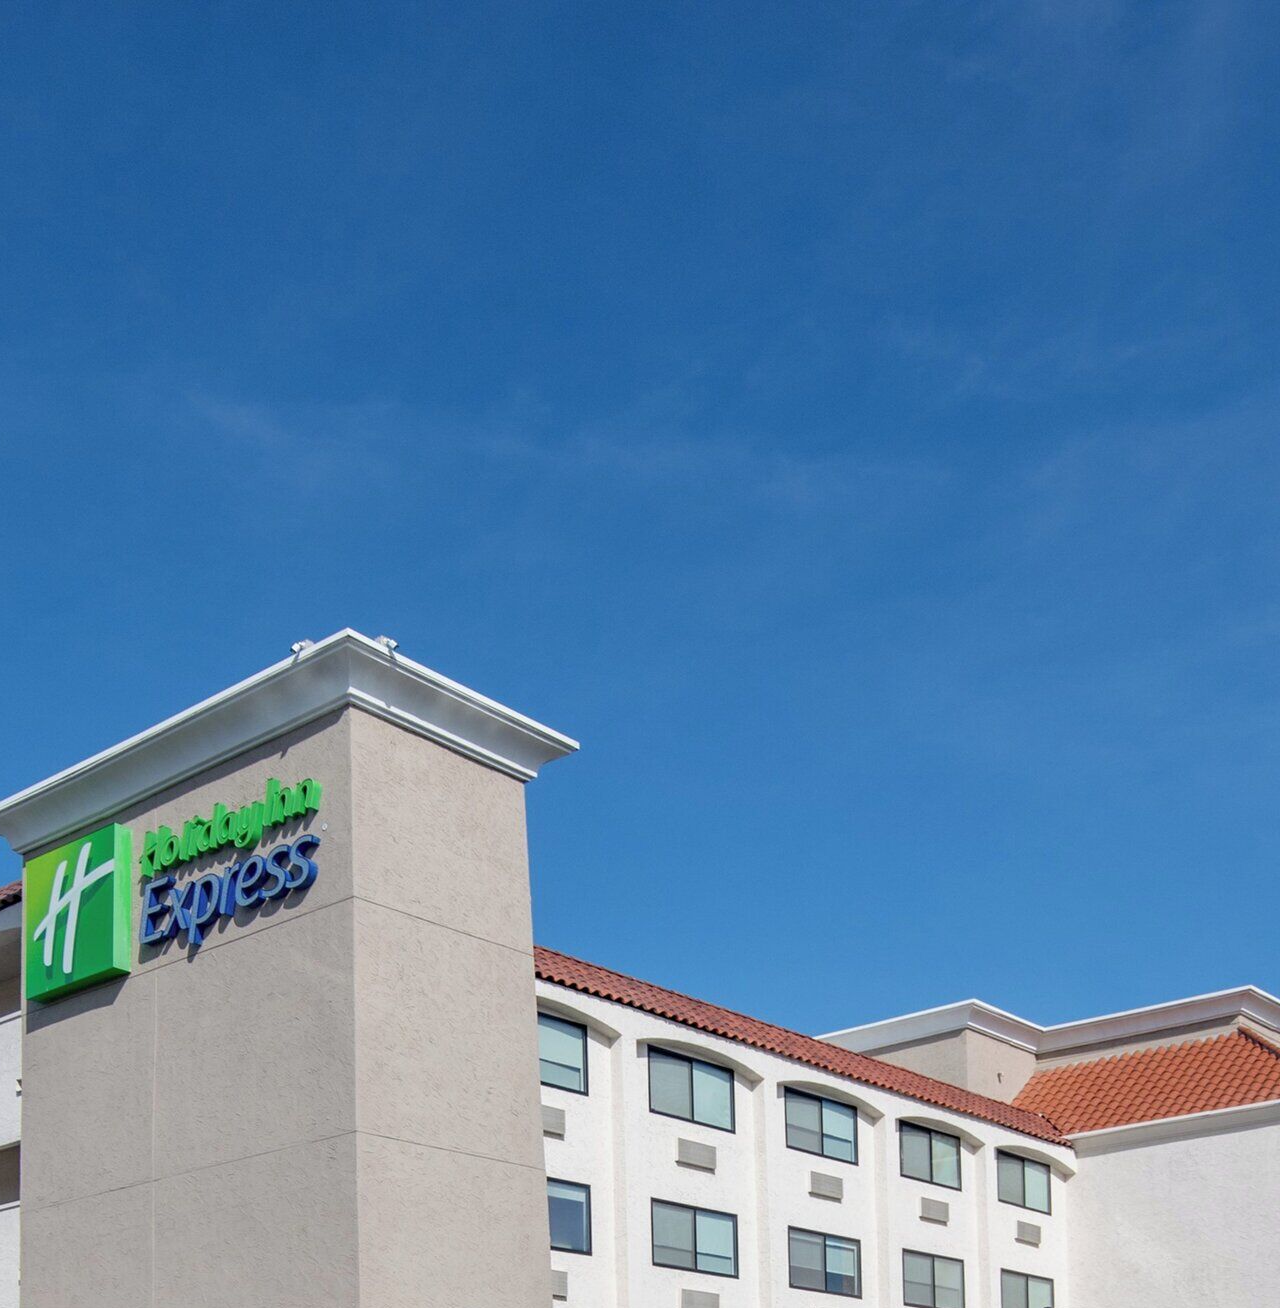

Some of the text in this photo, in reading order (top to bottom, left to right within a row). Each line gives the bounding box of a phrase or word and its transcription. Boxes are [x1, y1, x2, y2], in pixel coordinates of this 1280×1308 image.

[141, 778, 323, 878] Holiday Inn
[139, 834, 320, 946] Express
